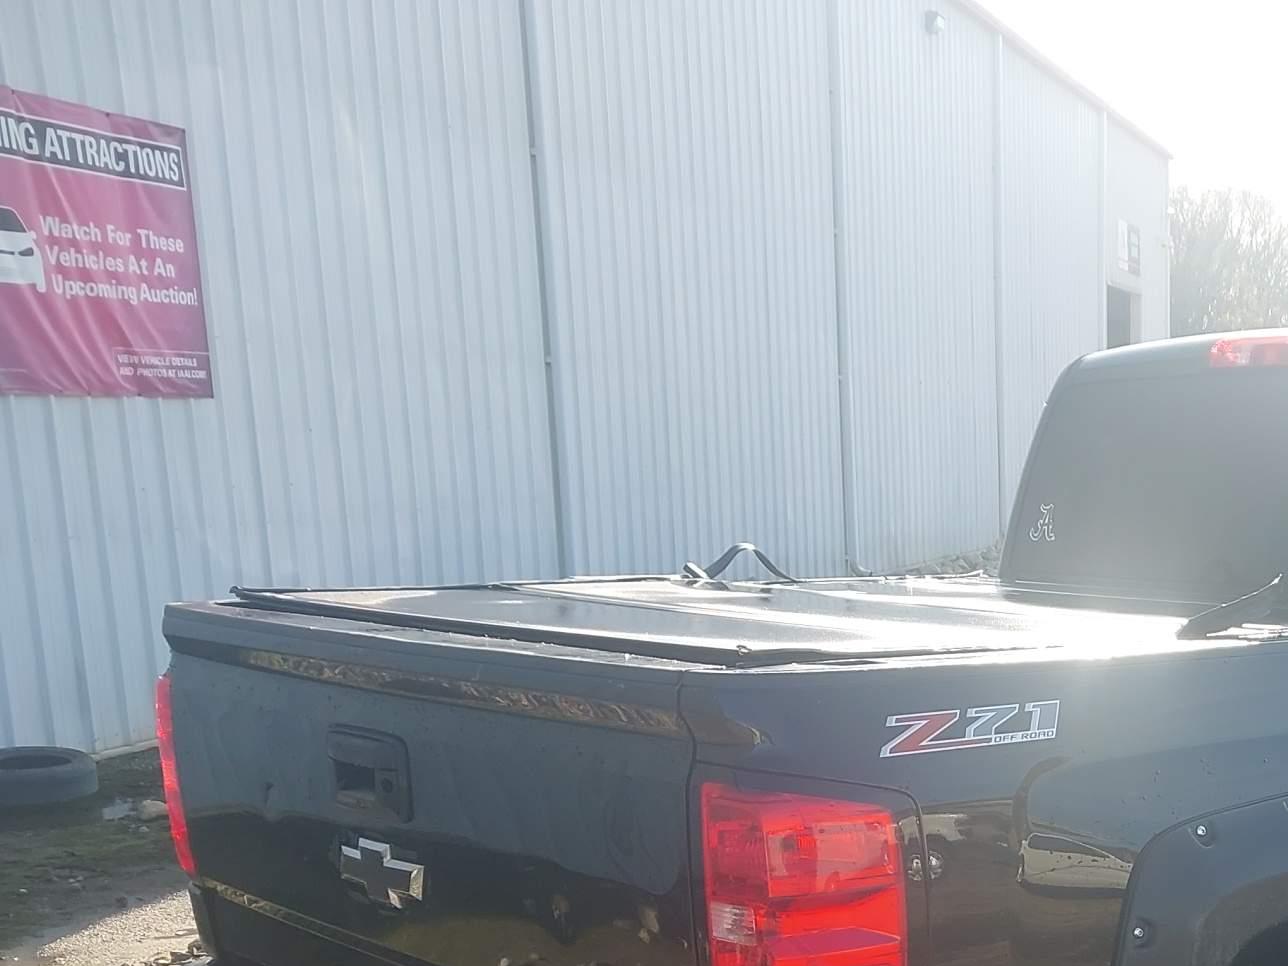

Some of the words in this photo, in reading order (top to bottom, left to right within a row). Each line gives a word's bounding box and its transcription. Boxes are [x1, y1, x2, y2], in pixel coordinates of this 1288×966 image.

[0, 115, 40, 155] ING
[45, 127, 180, 182] ATTRACTIONS
[40, 215, 102, 243] Watch
[107, 224, 132, 248] For
[137, 229, 185, 253] These
[45, 245, 125, 273] Vehicles
[128, 254, 148, 275] At
[154, 258, 176, 279] An
[51, 274, 138, 304] Upcoming
[140, 280, 198, 306] Auction!
[880, 699, 1060, 757] Z71
[994, 734, 1018, 744] OFF
[1021, 730, 1055, 740] ROAD
